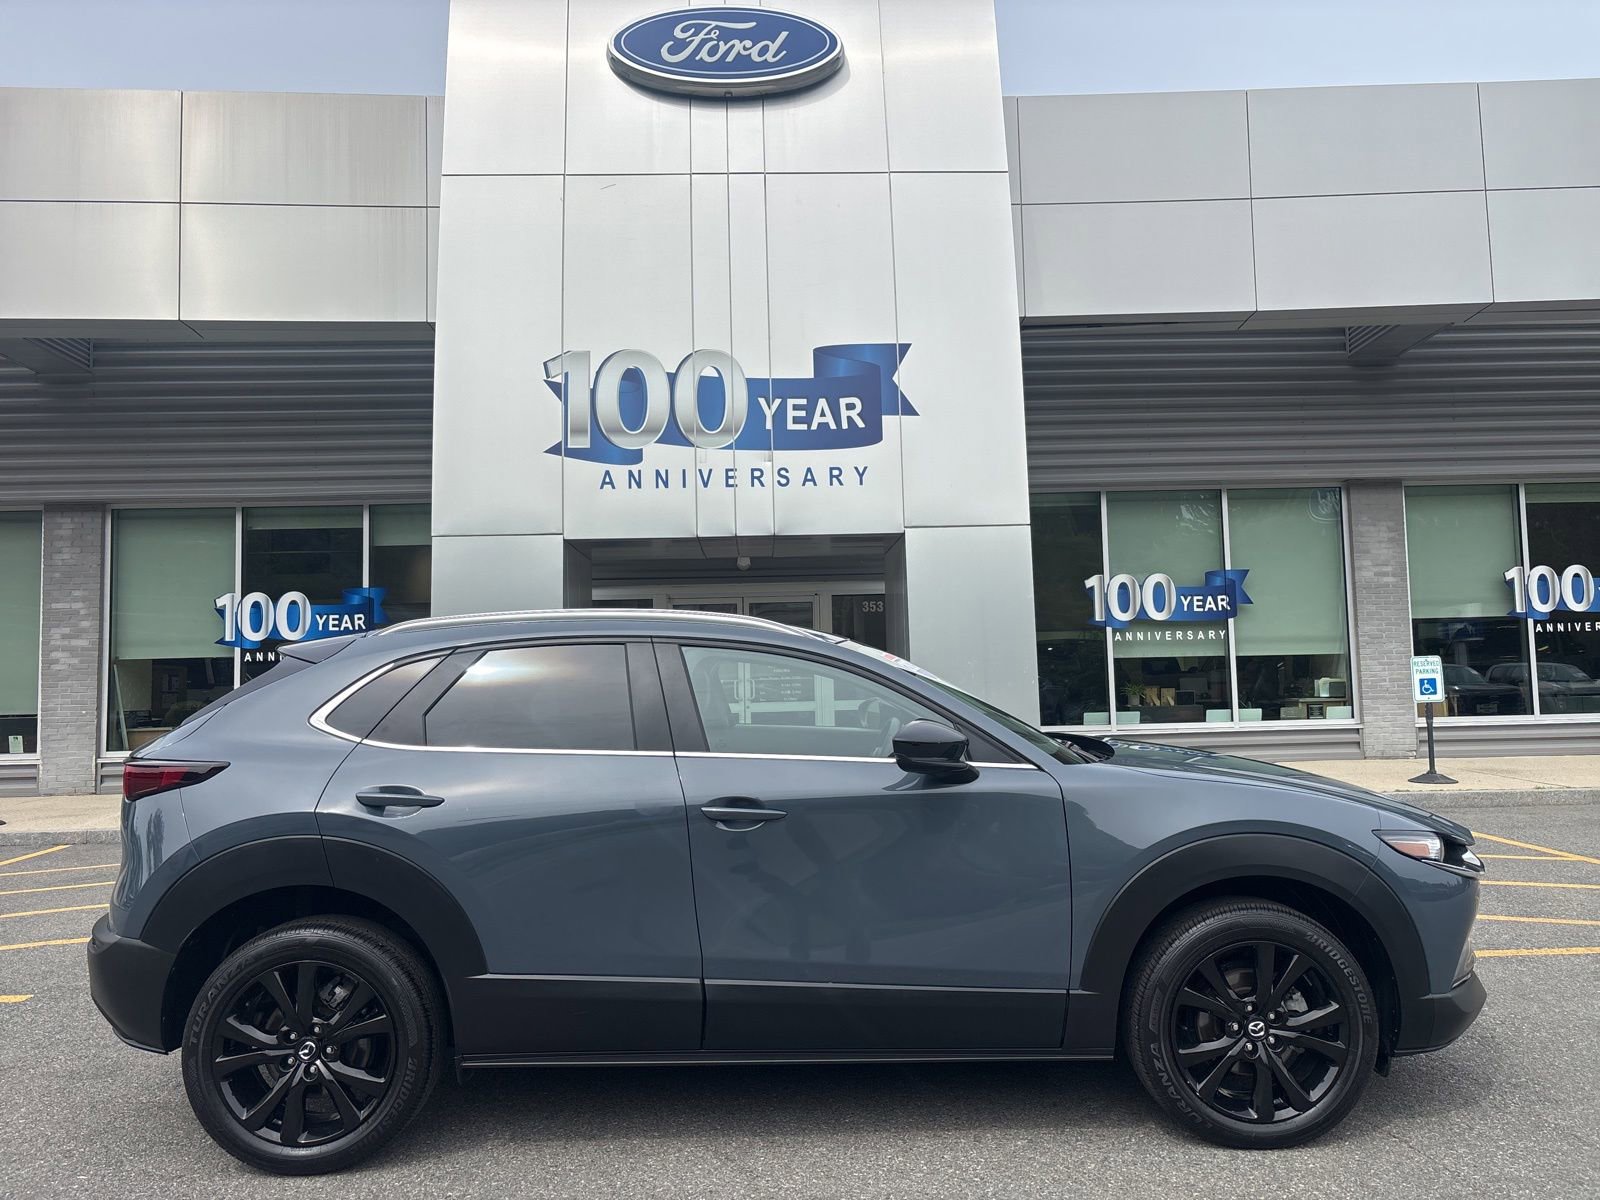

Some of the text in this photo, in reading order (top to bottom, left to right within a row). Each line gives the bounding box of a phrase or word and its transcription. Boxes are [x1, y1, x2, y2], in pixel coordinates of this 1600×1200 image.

[660, 20, 789, 63] Ford
[543, 349, 866, 450] 100 YEAR
[599, 466, 869, 490] ANNIVERSARY
[862, 601, 884, 612] 353
[1084, 572, 1231, 622] 100 YEAR
[1504, 564, 1595, 613] 100
[214, 591, 367, 642] 100 YEAR
[1114, 630, 1226, 642] ANNIVERSARY
[1304, 931, 1373, 1024] BRIDGESTONE
